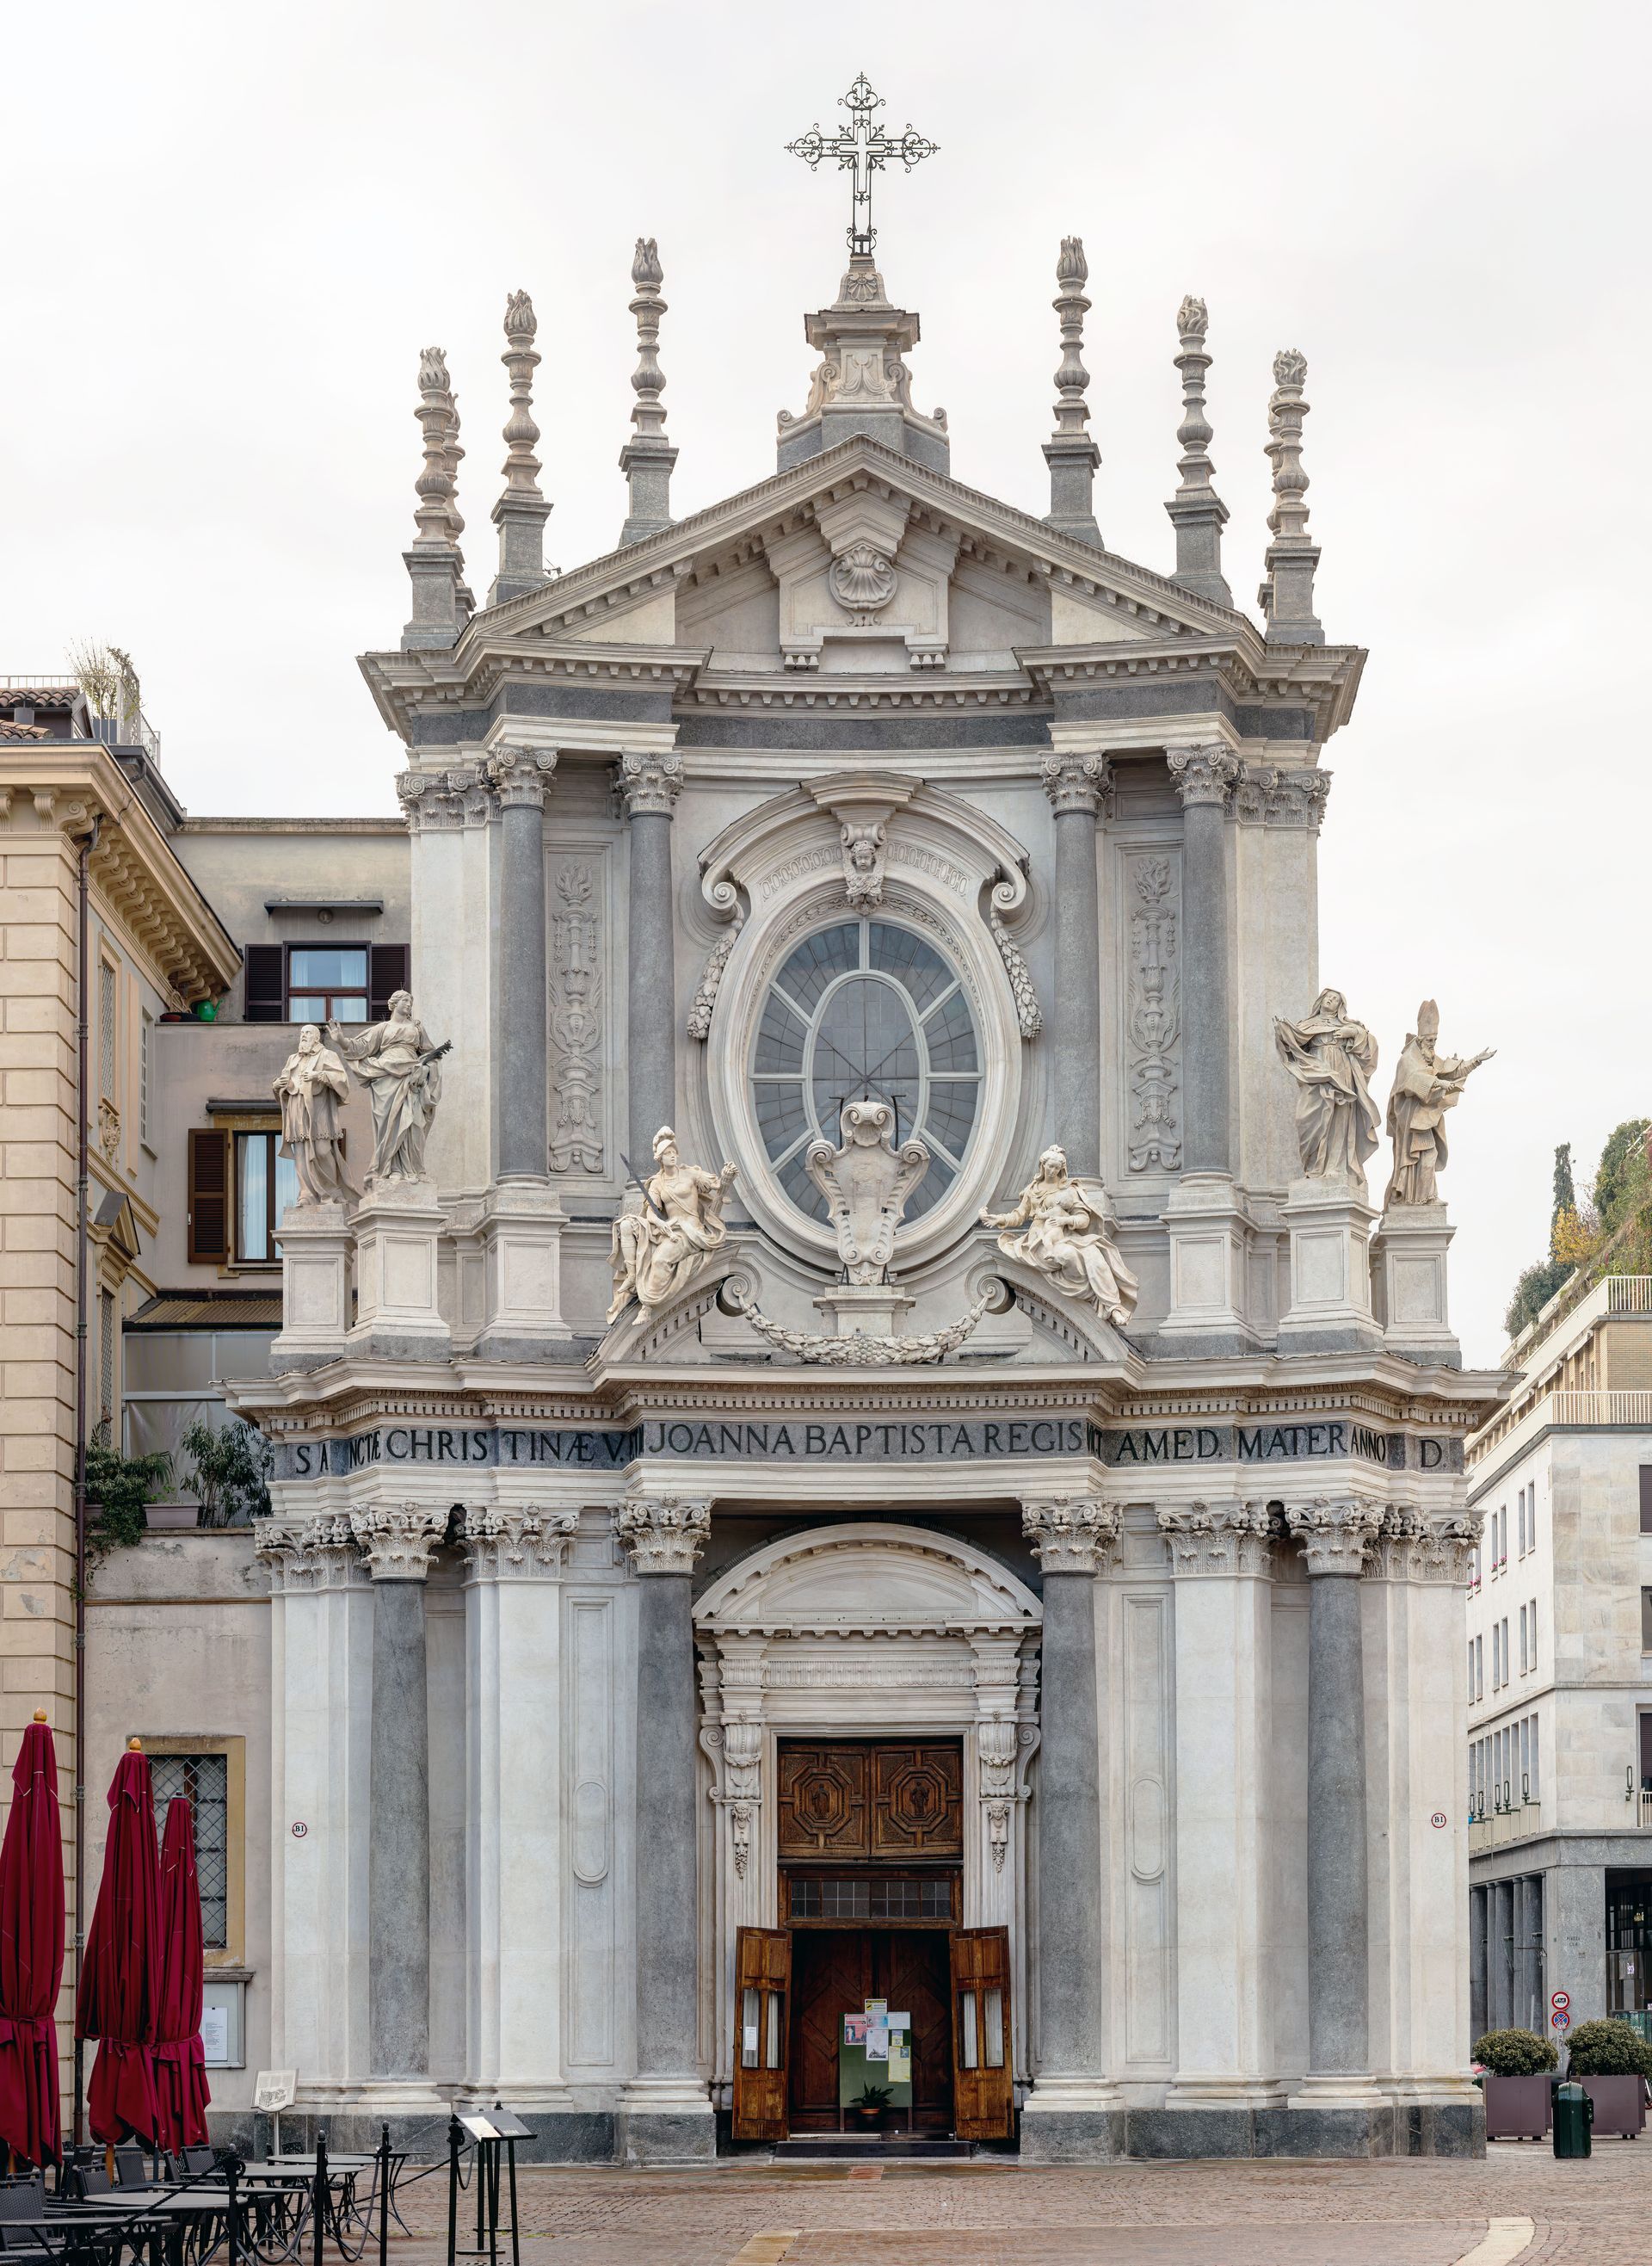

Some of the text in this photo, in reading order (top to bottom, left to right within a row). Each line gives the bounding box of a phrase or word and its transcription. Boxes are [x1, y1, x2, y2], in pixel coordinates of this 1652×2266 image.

[649, 1423, 795, 1454] JOANNA
[804, 1424, 976, 1454] BAPTISTA
[983, 1422, 1082, 1453] REGIS
[1116, 1429, 1223, 1460] AMED.
[1237, 1424, 1348, 1459] MATER
[1350, 1425, 1386, 1462] ANNO
[1420, 1439, 1446, 1468] D.
